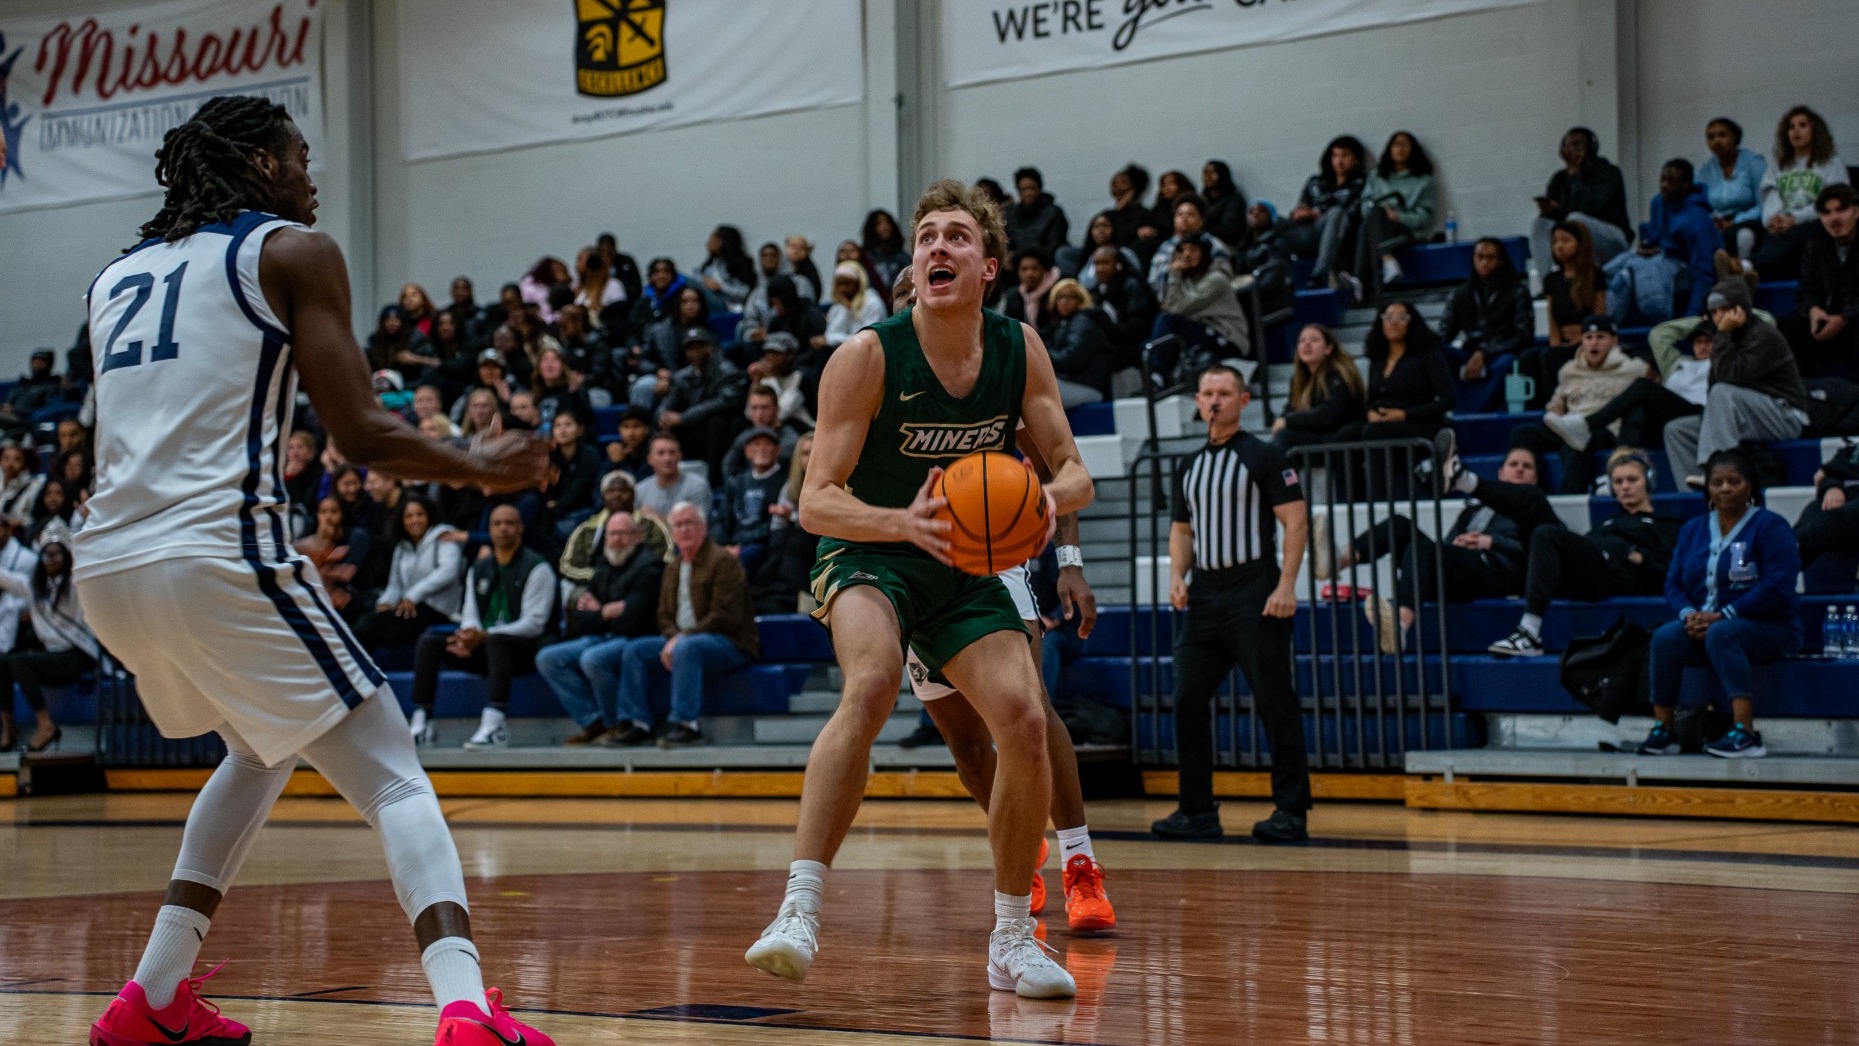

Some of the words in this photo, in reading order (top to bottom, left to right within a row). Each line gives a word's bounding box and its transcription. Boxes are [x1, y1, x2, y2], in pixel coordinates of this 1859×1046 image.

[34, 0, 318, 107] Missouri
[993, 0, 1104, 43] WE'RE
[101, 260, 190, 375] 21
[908, 421, 1005, 452] MINERS
